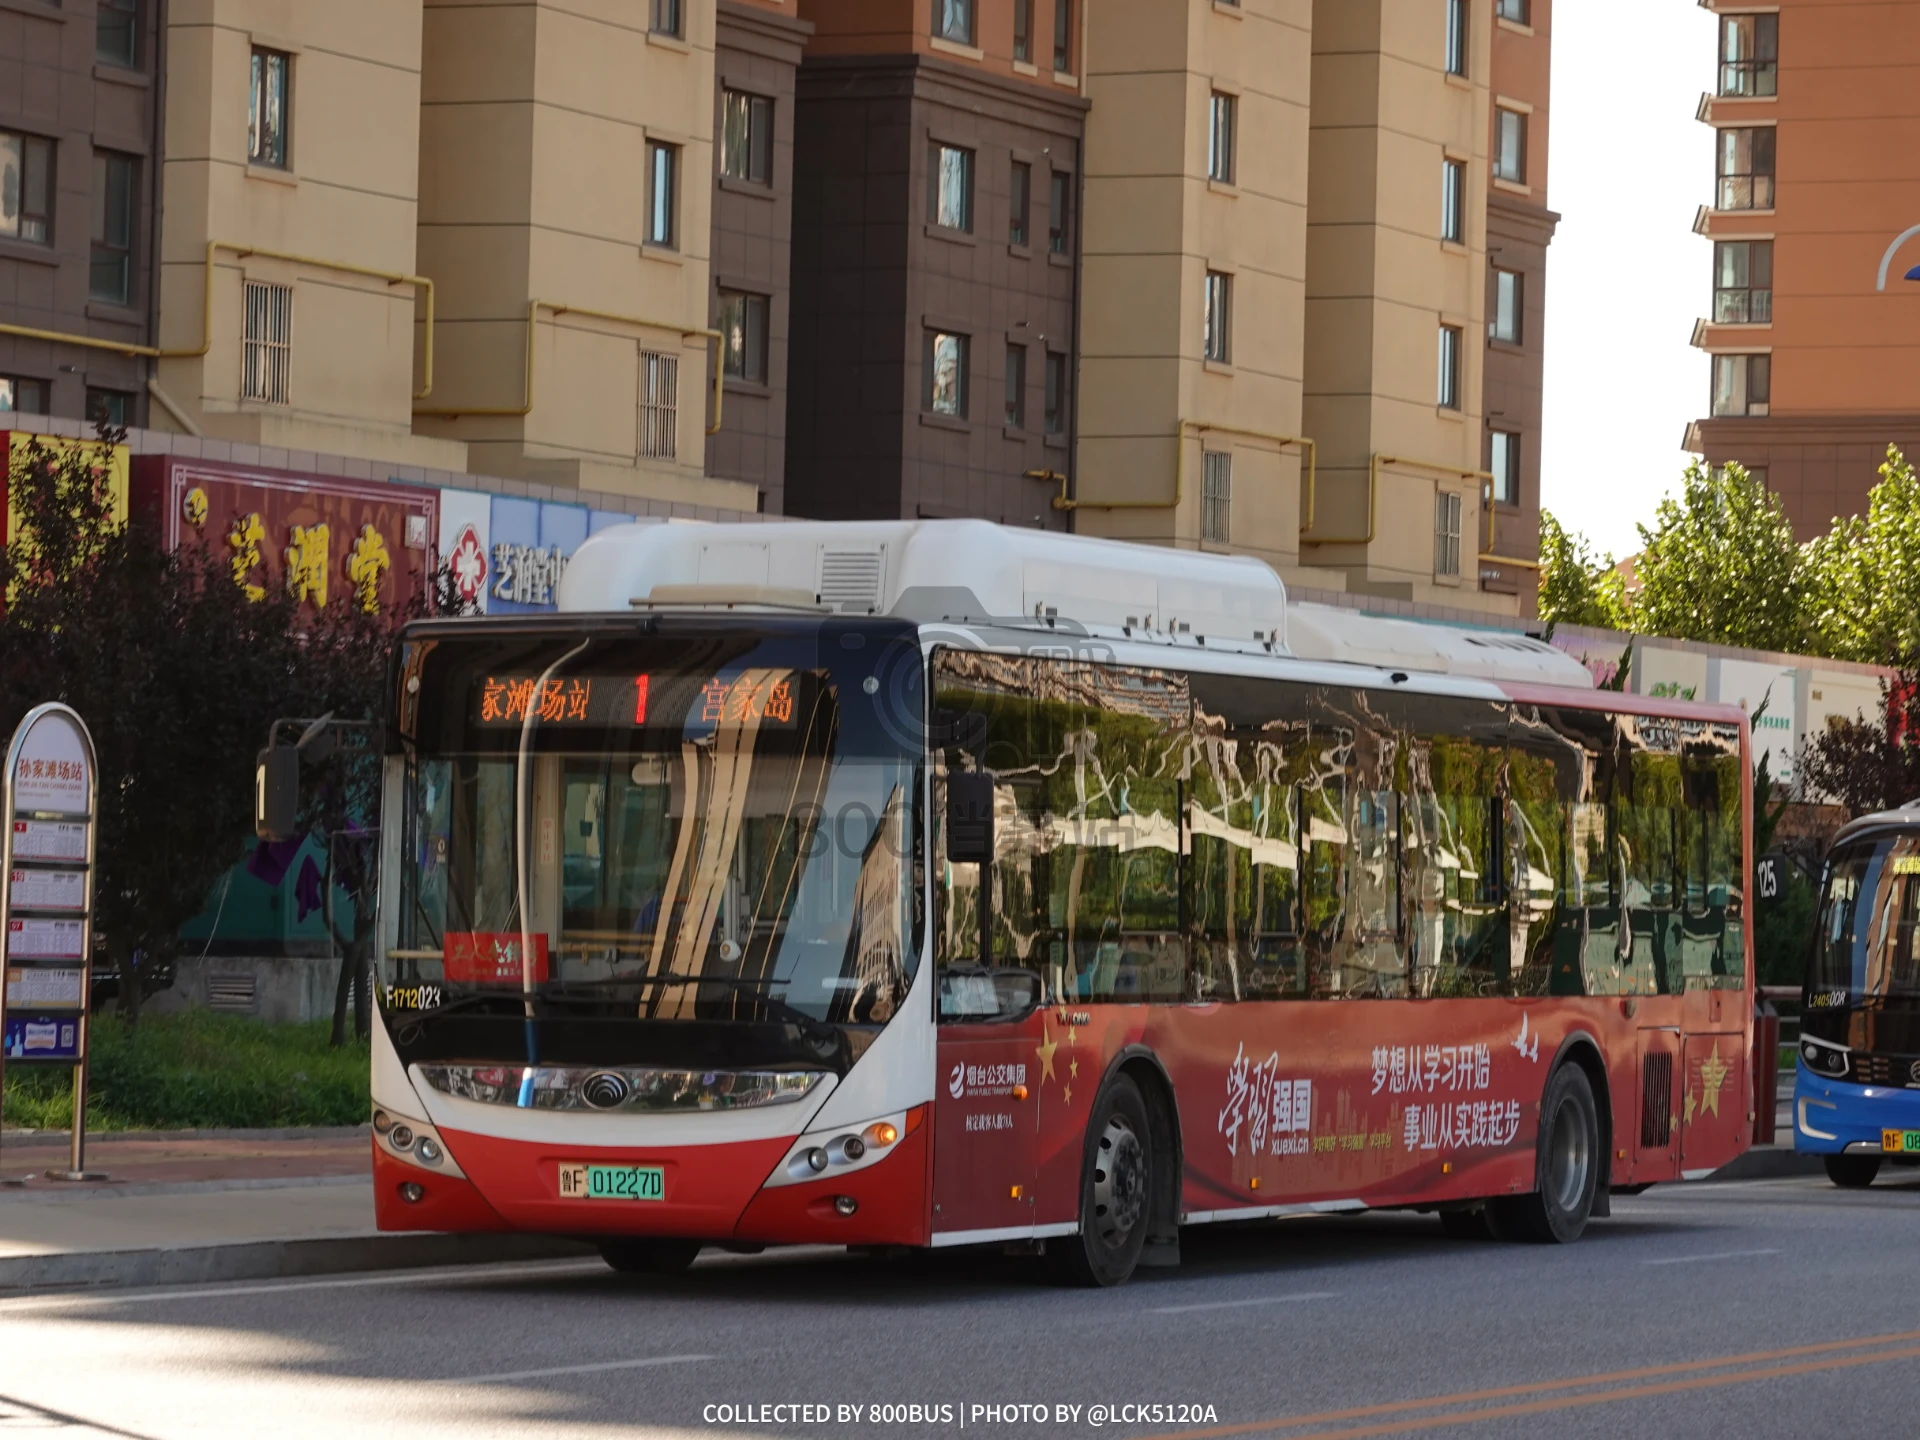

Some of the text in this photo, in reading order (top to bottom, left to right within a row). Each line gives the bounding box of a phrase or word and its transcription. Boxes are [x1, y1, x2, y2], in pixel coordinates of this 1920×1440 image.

[634, 674, 649, 724] 1
[256, 764, 266, 821] 1
[1757, 860, 1777, 898] 125
[966, 1063, 1027, 1087] 烟台公交集团
[1371, 1042, 1491, 1096] 梦想从学习开始
[1271, 1132, 1309, 1156] xuexi.cn
[1369, 1132, 1392, 1149] 学习平台
[1403, 1098, 1521, 1152] 事业从实践起步
